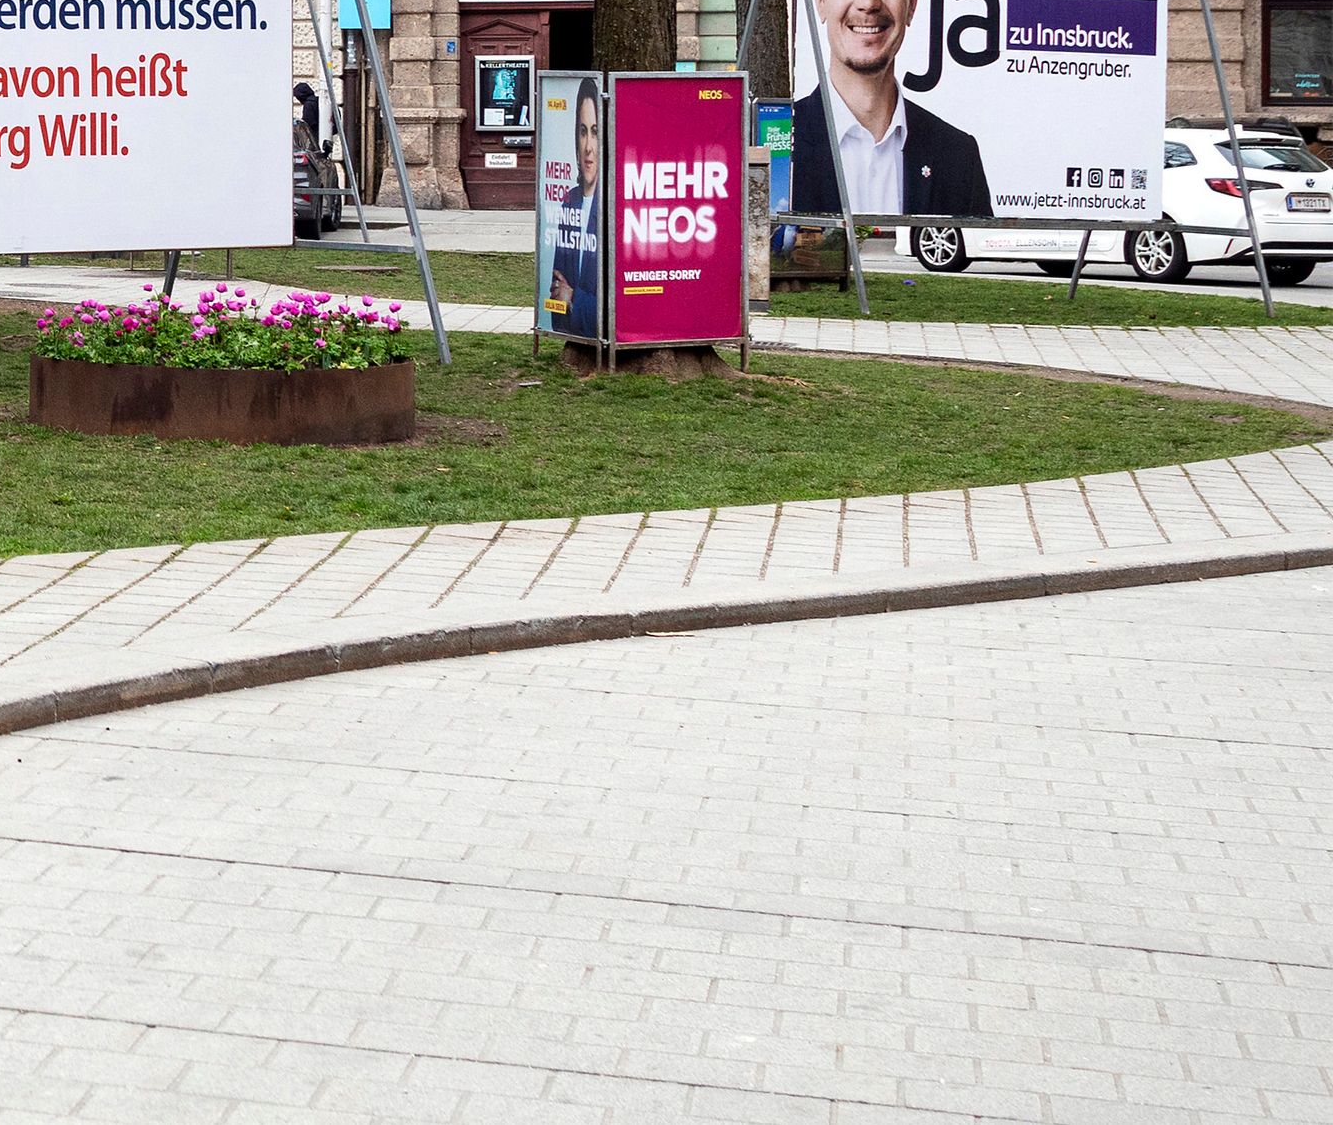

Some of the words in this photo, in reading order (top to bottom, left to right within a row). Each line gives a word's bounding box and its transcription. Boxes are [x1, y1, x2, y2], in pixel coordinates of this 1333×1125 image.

[1008, 26, 1033, 45] zu
[1036, 22, 1134, 49] Innsbruck.
[90, 51, 189, 98] heißt
[1006, 58, 1026, 74] zu
[1028, 55, 1132, 80] Anzengruber.
[698, 89, 723, 100] NEOS
[38, 112, 130, 157] Willi.
[545, 160, 572, 181] MEHR
[623, 161, 729, 200] MEHR
[544, 183, 570, 203] NEOS
[996, 191, 1146, 210] www.jetzt-innsbruck.at
[622, 205, 718, 244] NEOS
[543, 227, 598, 253] STILLSTAND
[623, 269, 669, 282] WENIGER
[669, 269, 702, 281] SORRY
